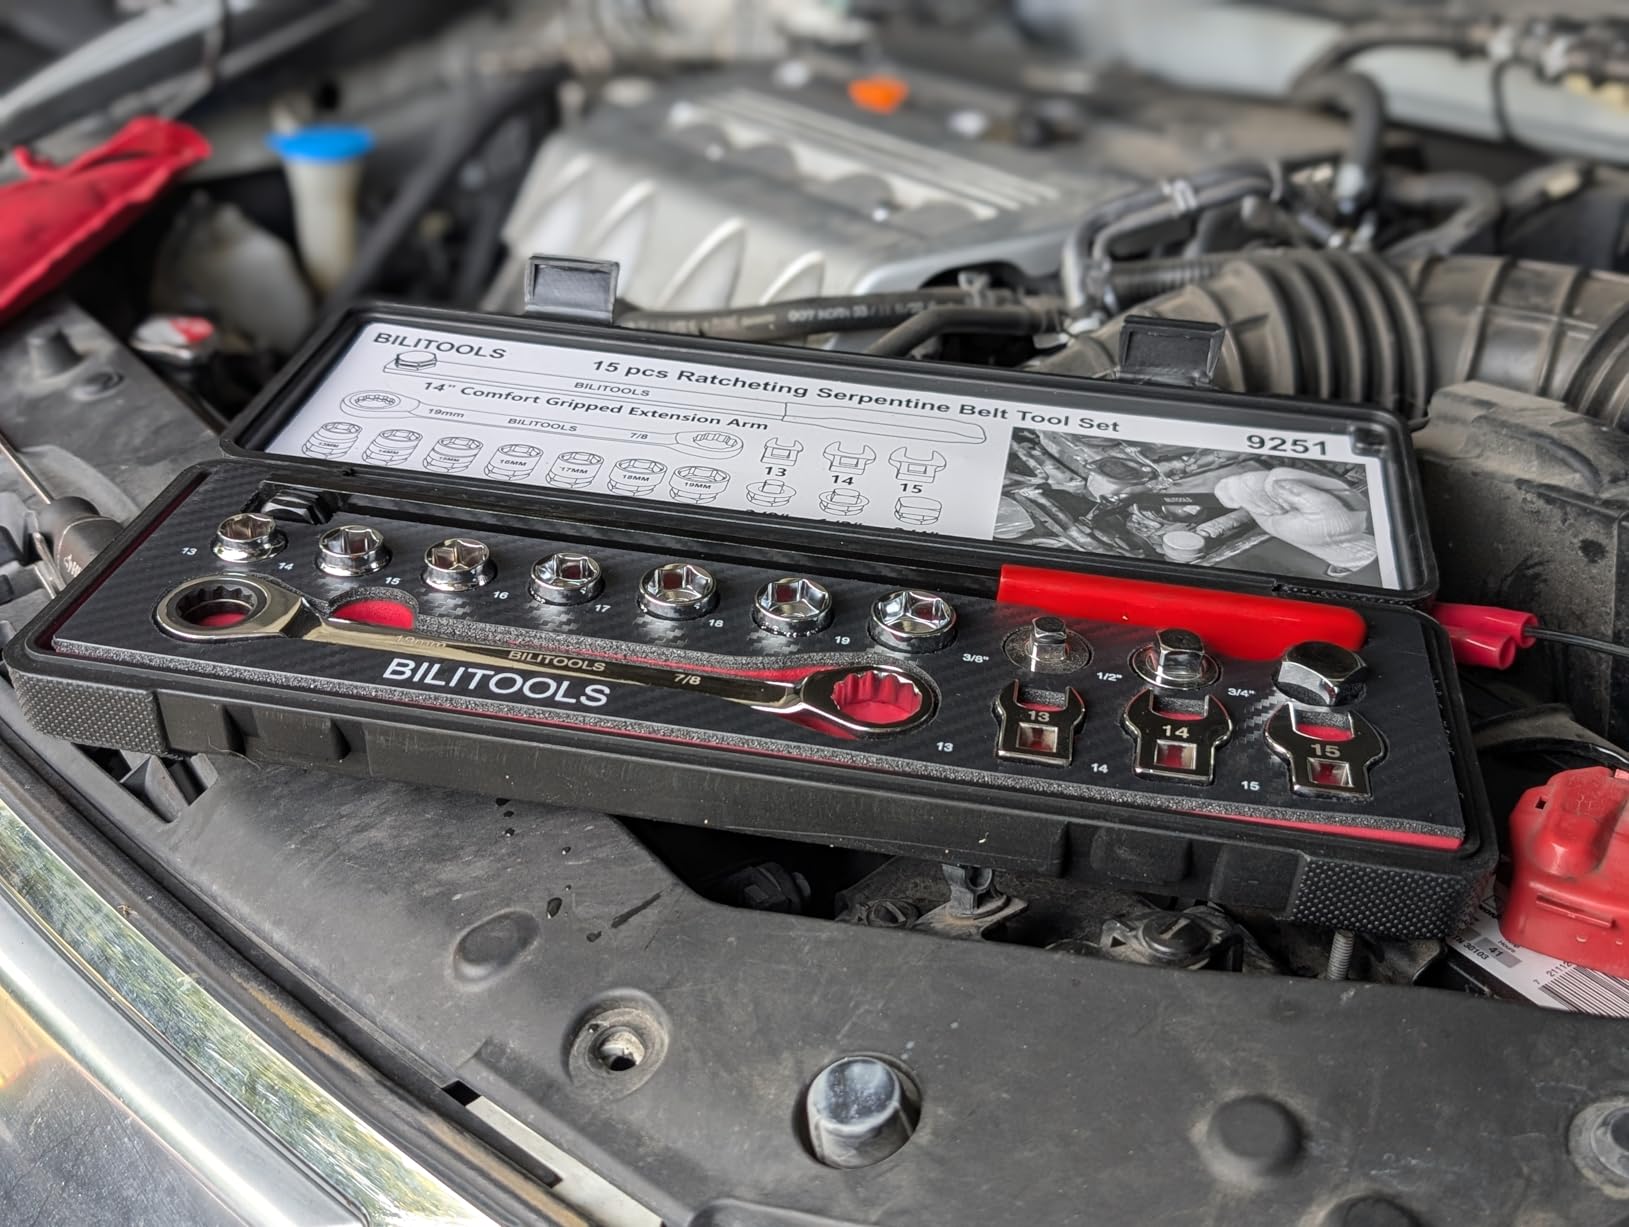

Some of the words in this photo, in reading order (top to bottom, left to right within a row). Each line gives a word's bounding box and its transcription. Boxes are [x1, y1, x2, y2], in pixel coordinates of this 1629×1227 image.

[373, 331, 508, 359] BILITOOLS
[573, 381, 651, 397] BILITOOLS
[593, 361, 619, 373] 15
[624, 365, 669, 380] pcs
[677, 369, 809, 398] Ratcheting
[816, 387, 950, 413] Serpentine
[959, 404, 1008, 420] Belt
[1016, 410, 1070, 427] Tool
[1078, 416, 1121, 433] Set
[427, 407, 465, 419] 19mm
[460, 386, 540, 405] Comfort
[546, 393, 624, 414] Gripped
[627, 406, 721, 425] Extension
[726, 415, 769, 431] Arm
[507, 417, 578, 433] BILITOOLS
[629, 431, 649, 441] 7/8
[1245, 434, 1329, 456] 9251
[499, 458, 527, 468] 16MM
[561, 466, 589, 476] 17MM
[765, 466, 787, 478] 13
[622, 473, 650, 483] 18MM
[831, 474, 854, 486] 14
[684, 481, 712, 491] 19MM
[900, 482, 923, 494] 15
[181, 546, 198, 557] 13
[277, 561, 295, 571] 14
[384, 575, 401, 586] 15
[493, 590, 509, 600] 16
[594, 604, 611, 614] 17
[708, 618, 724, 628] 18
[834, 635, 851, 645] 19
[508, 649, 607, 672] BILITOOLS
[383, 657, 611, 707] BILITOOLS
[672, 673, 702, 686] 7/8
[1028, 710, 1051, 723] 13
[1162, 724, 1190, 739] 14
[936, 741, 954, 752] 13
[1311, 743, 1341, 758] 15
[1091, 762, 1109, 773] 14
[1241, 780, 1261, 791] 15
[1489, 947, 1503, 957] 41
